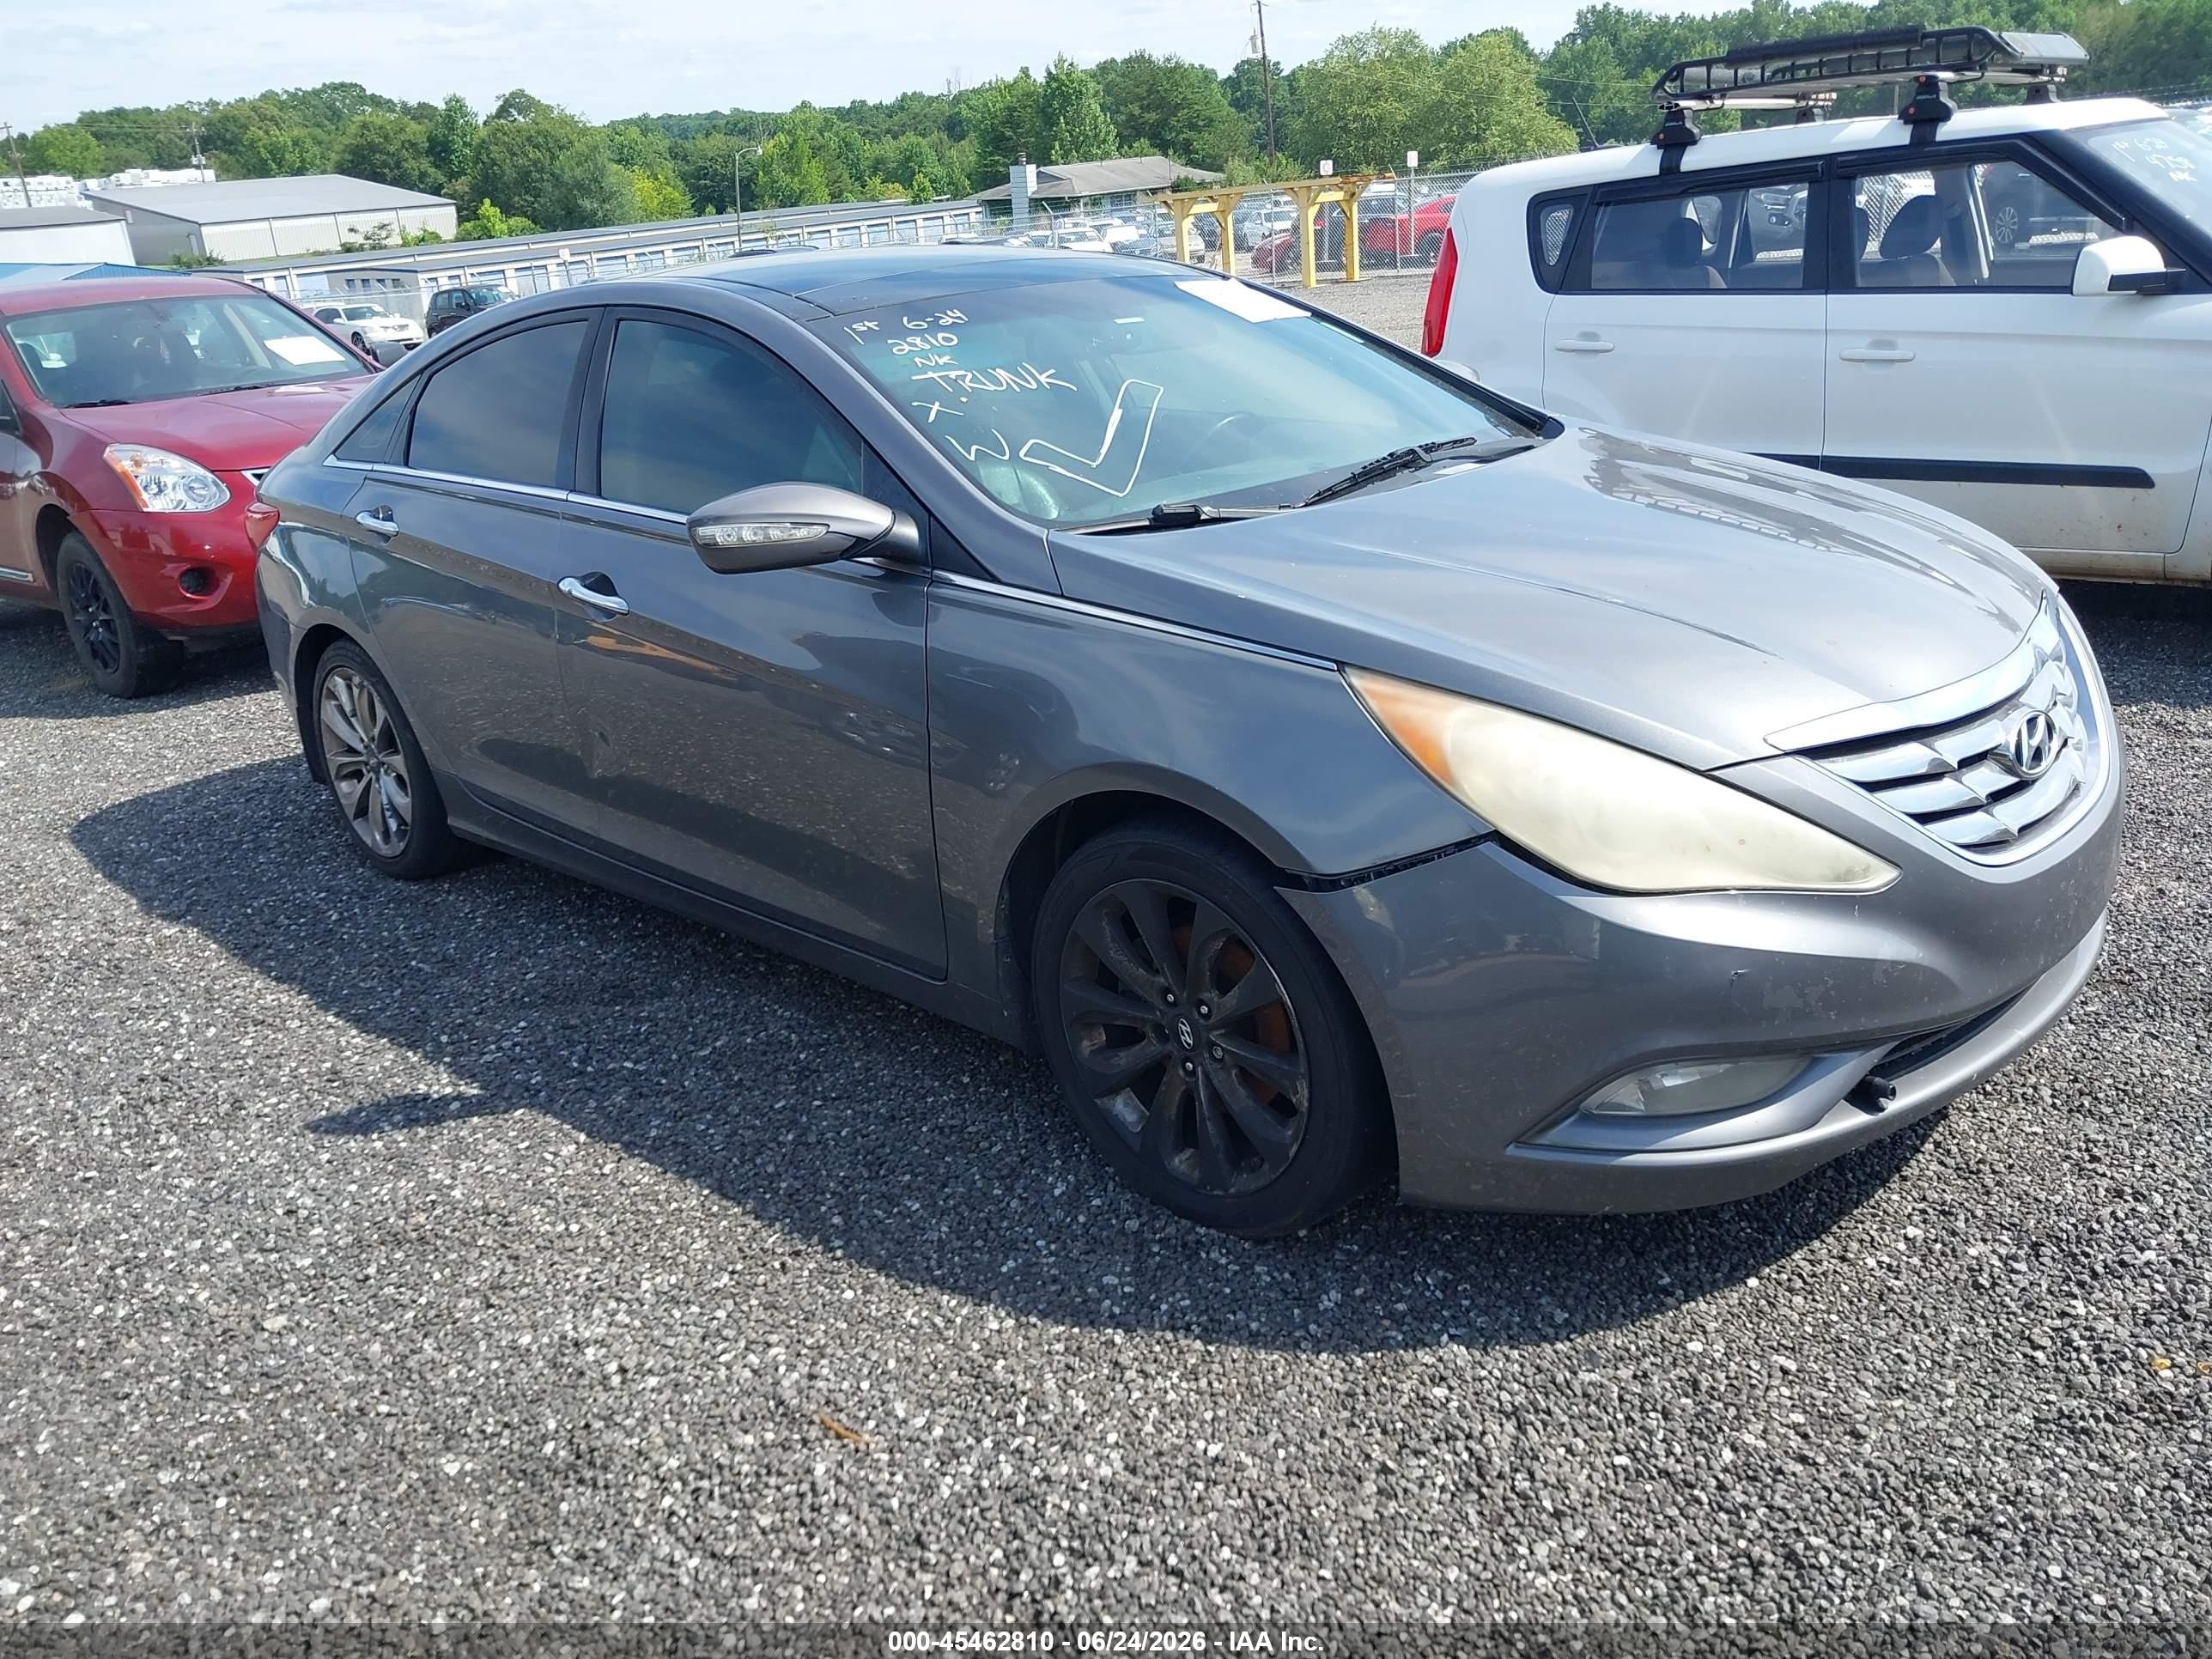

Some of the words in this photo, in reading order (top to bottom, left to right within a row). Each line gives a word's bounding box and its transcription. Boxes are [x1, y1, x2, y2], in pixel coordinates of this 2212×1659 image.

[843, 320, 880, 345] 1st
[902, 309, 969, 330] 6-24
[887, 332, 959, 355] 2810
[911, 362, 1079, 392] TRUNK
[945, 428, 1010, 461] W
